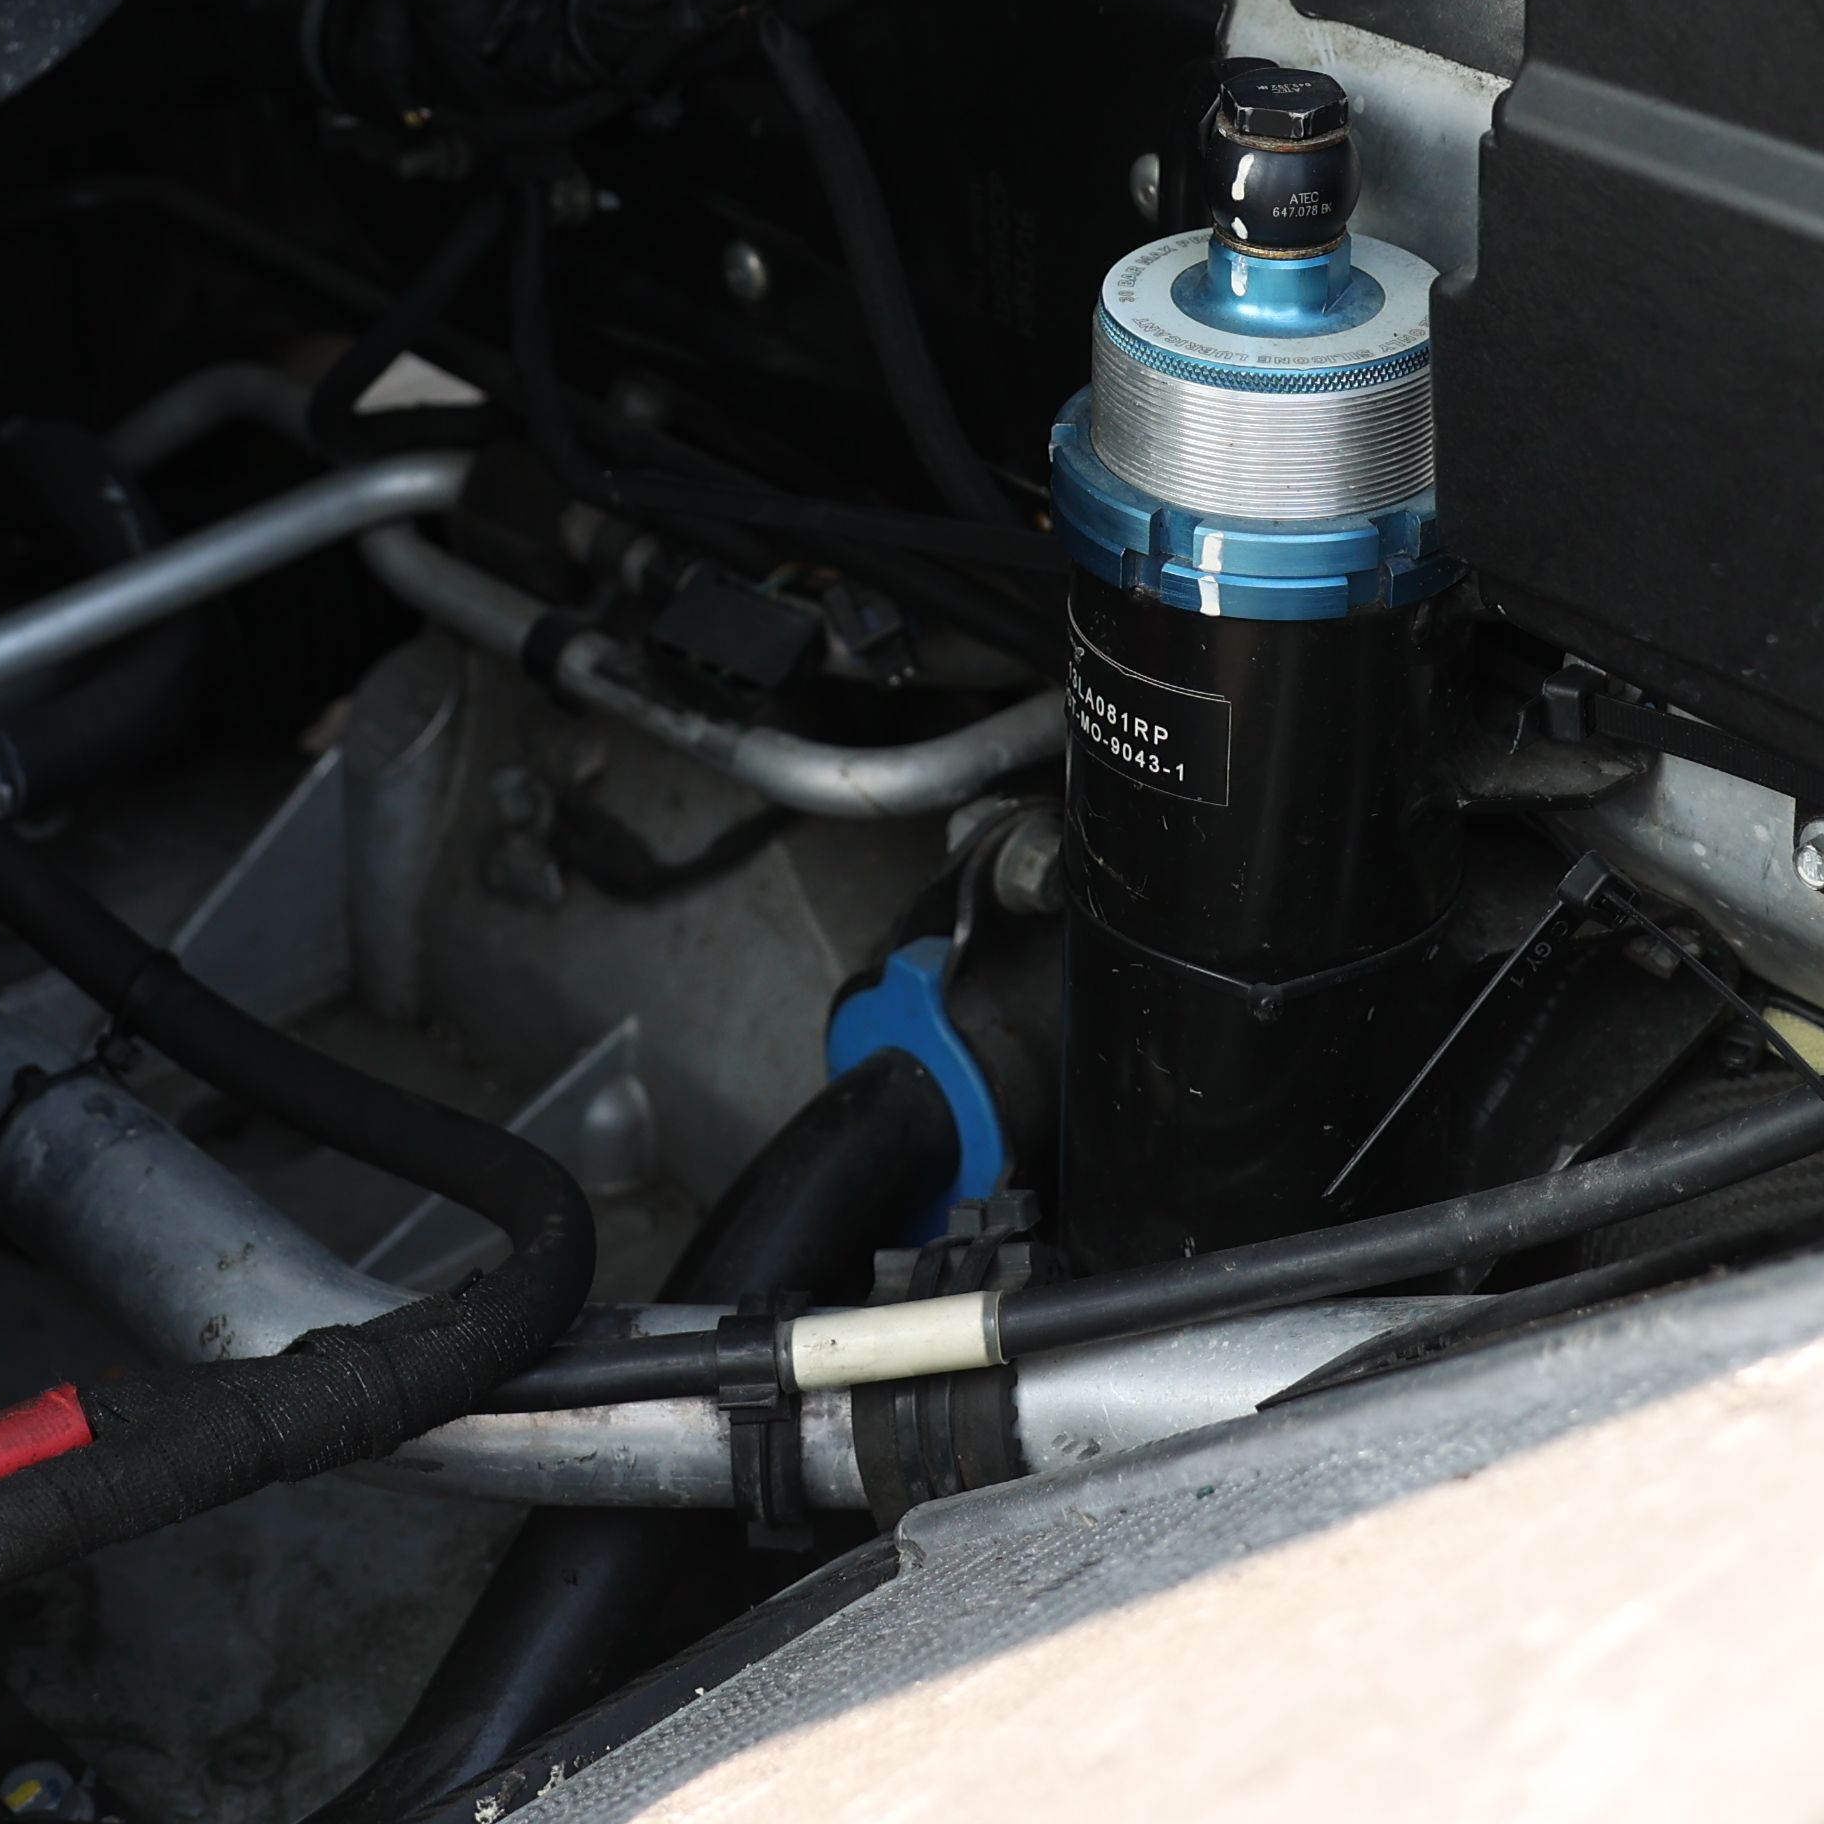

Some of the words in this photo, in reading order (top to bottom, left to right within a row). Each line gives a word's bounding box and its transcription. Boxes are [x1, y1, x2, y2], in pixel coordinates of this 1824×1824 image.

[1289, 191, 1320, 205] ATEC
[1272, 206, 1318, 218] 647.078
[1117, 265, 1146, 288] BAR
[1135, 244, 1178, 266] MAX
[1132, 316, 1249, 362] LUBRICANT
[1264, 347, 1375, 366] SILICONE
